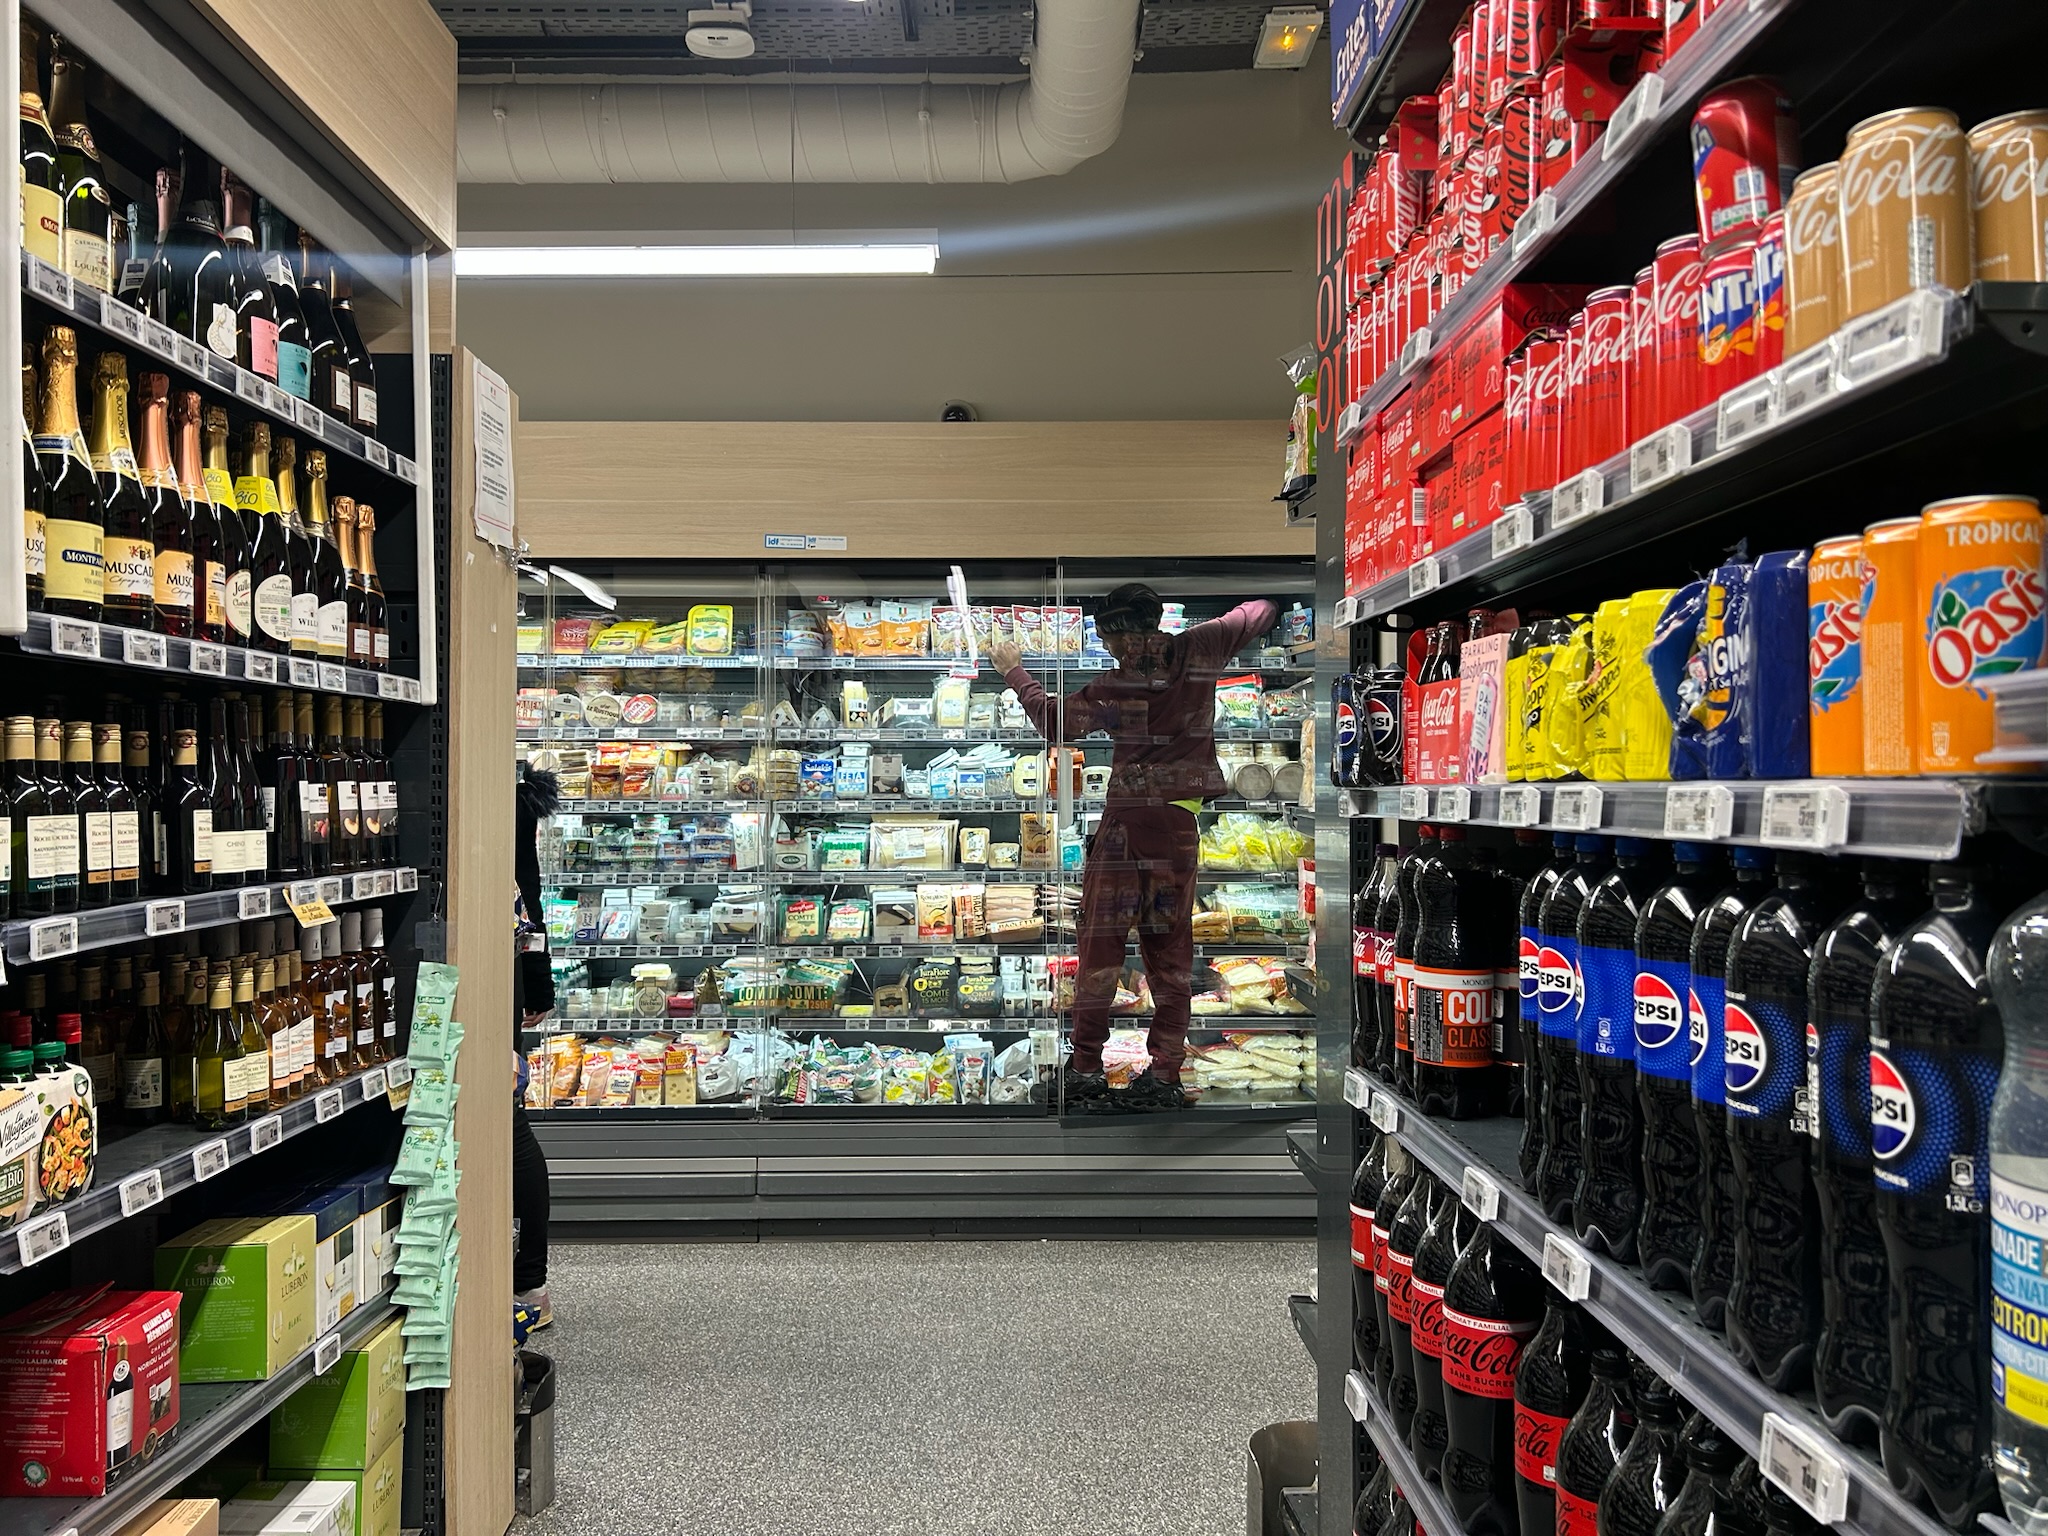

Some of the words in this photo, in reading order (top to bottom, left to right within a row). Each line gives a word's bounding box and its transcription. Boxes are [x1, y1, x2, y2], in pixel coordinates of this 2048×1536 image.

[1336, 3, 1366, 93] Frites
[74, 260, 99, 274] LOUIS
[1461, 638, 1499, 661] SPARKLING
[841, 772, 863, 780] FETA
[920, 989, 949, 997] COMTÉ
[7, 1168, 24, 1189] BIO
[185, 1275, 235, 1287] LUBERON
[281, 1270, 309, 1298] LUBERON
[1446, 1310, 1471, 1326] FORMAT
[1473, 1321, 1511, 1332] FAMILIAL
[26, 1358, 68, 1366] LALIBARDE
